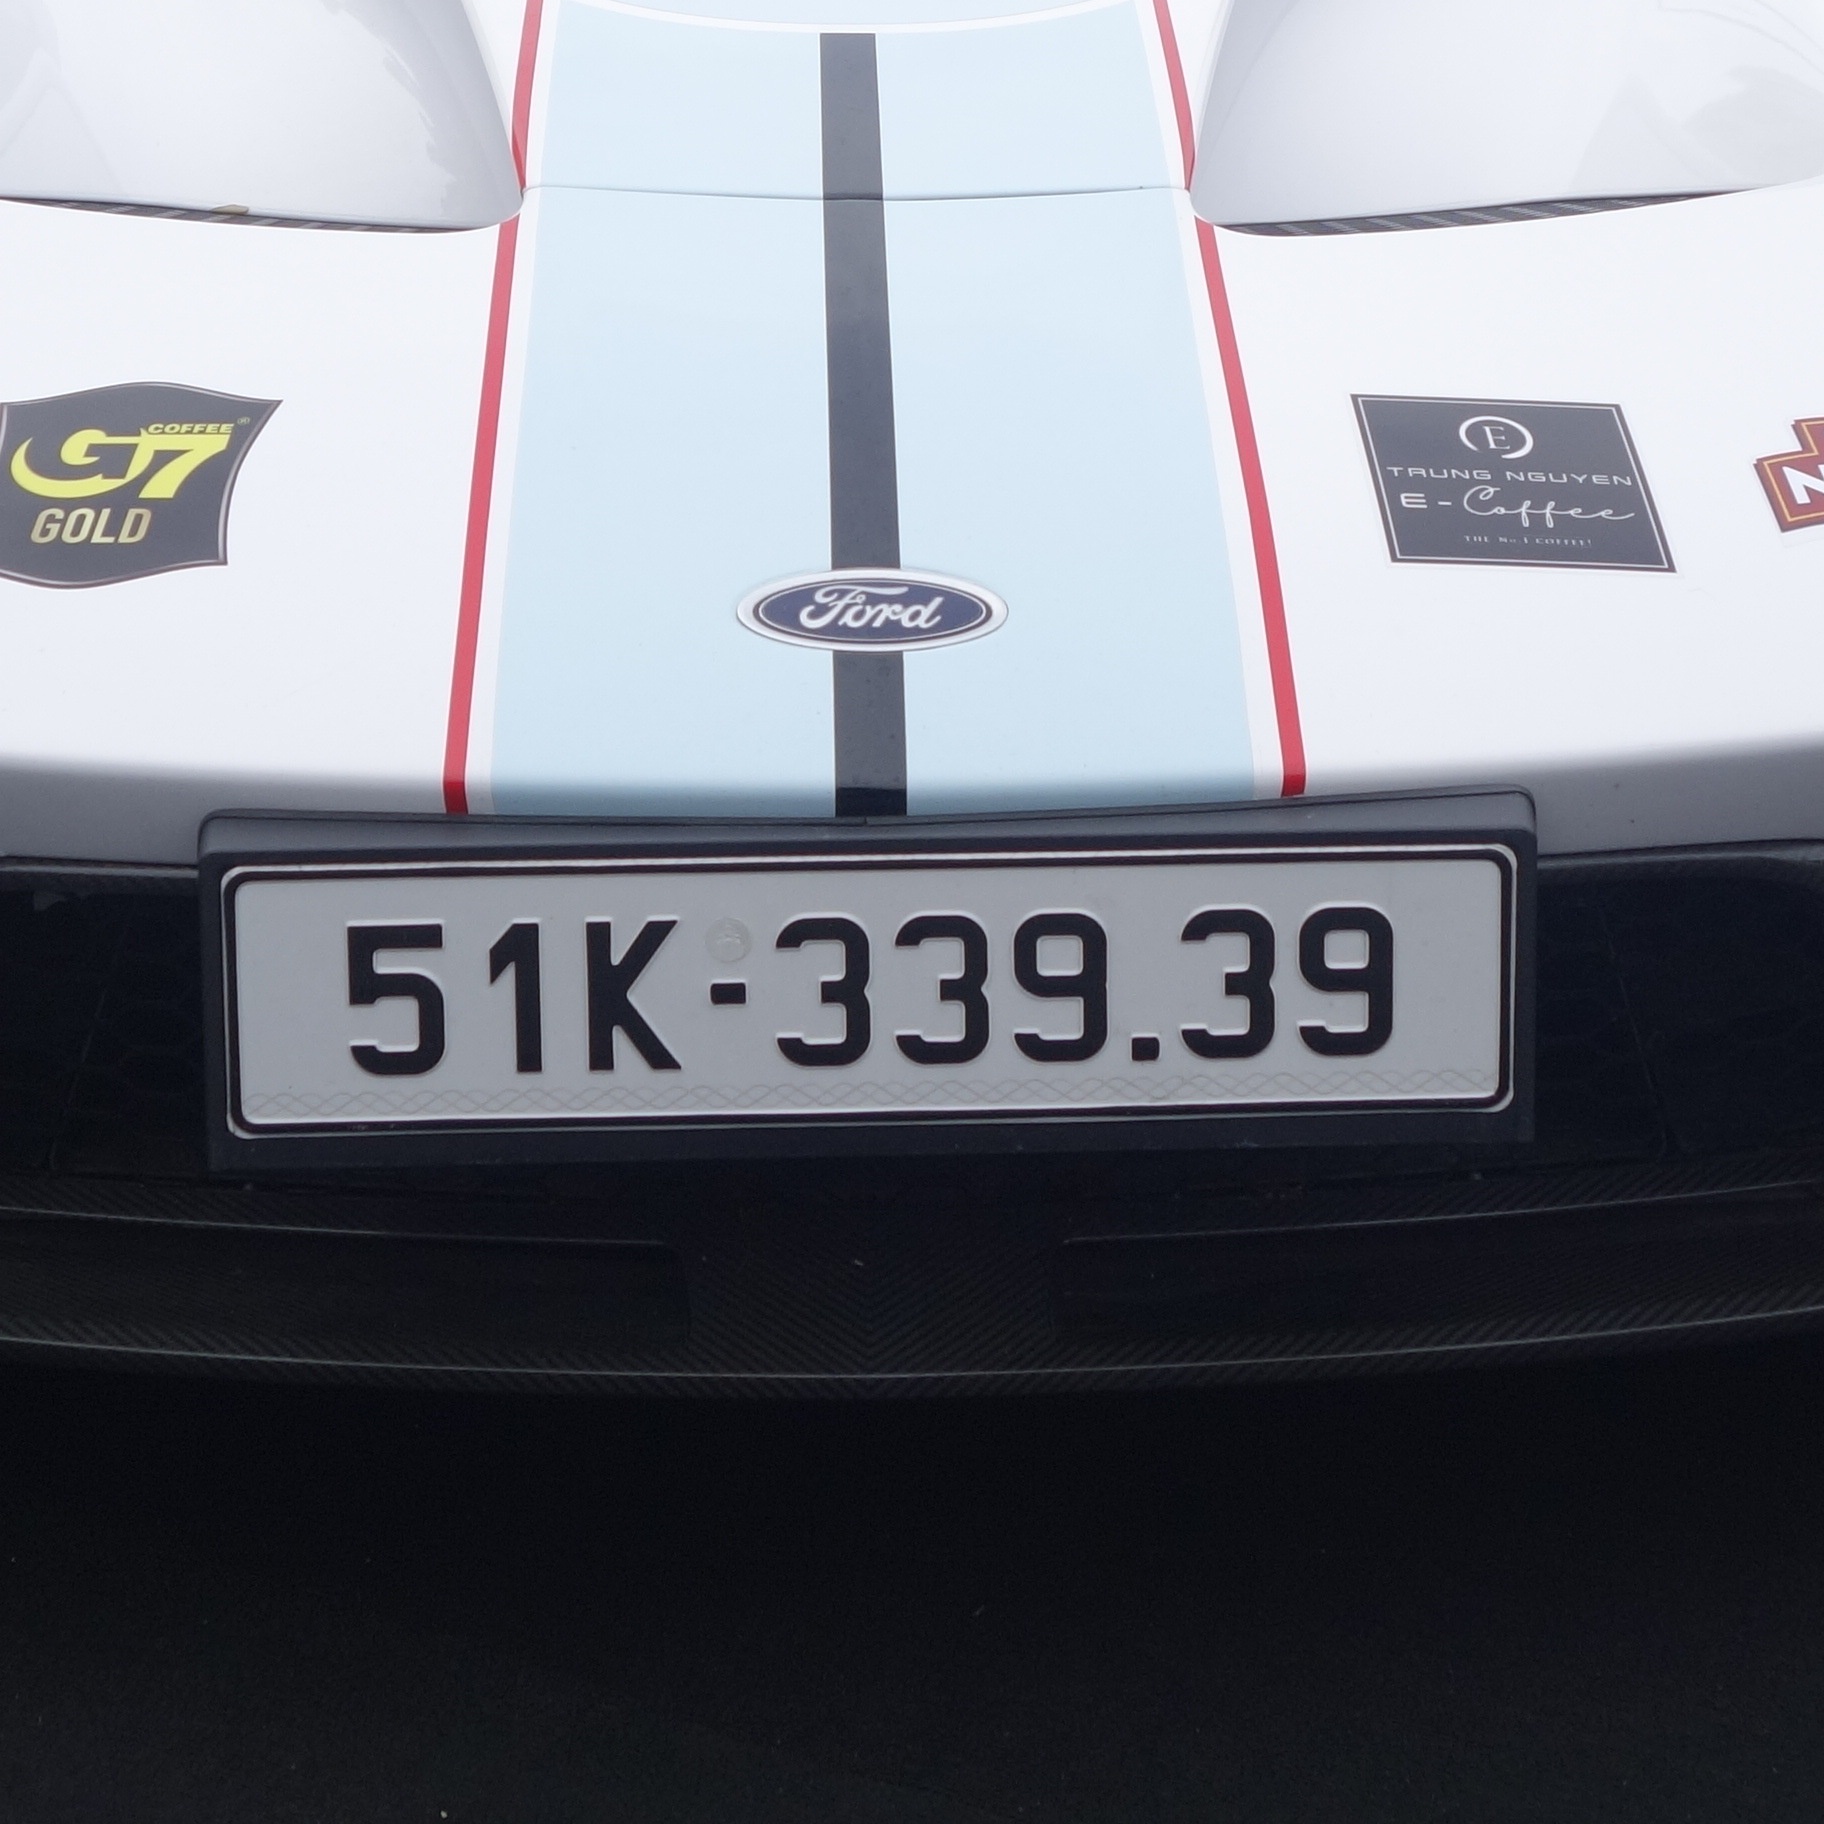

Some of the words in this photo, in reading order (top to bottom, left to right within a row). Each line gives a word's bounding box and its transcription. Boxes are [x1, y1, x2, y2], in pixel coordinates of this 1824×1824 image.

[146, 422, 236, 435] COFFEE
[10, 427, 230, 500] G7
[1386, 466, 1493, 481] TRUNG
[1505, 469, 1633, 487] NGUYEN
[30, 508, 154, 545] GOLD
[1463, 534, 1490, 544] THE
[798, 583, 944, 637] Ford
[345, 903, 1397, 1078] 51K-339.39
